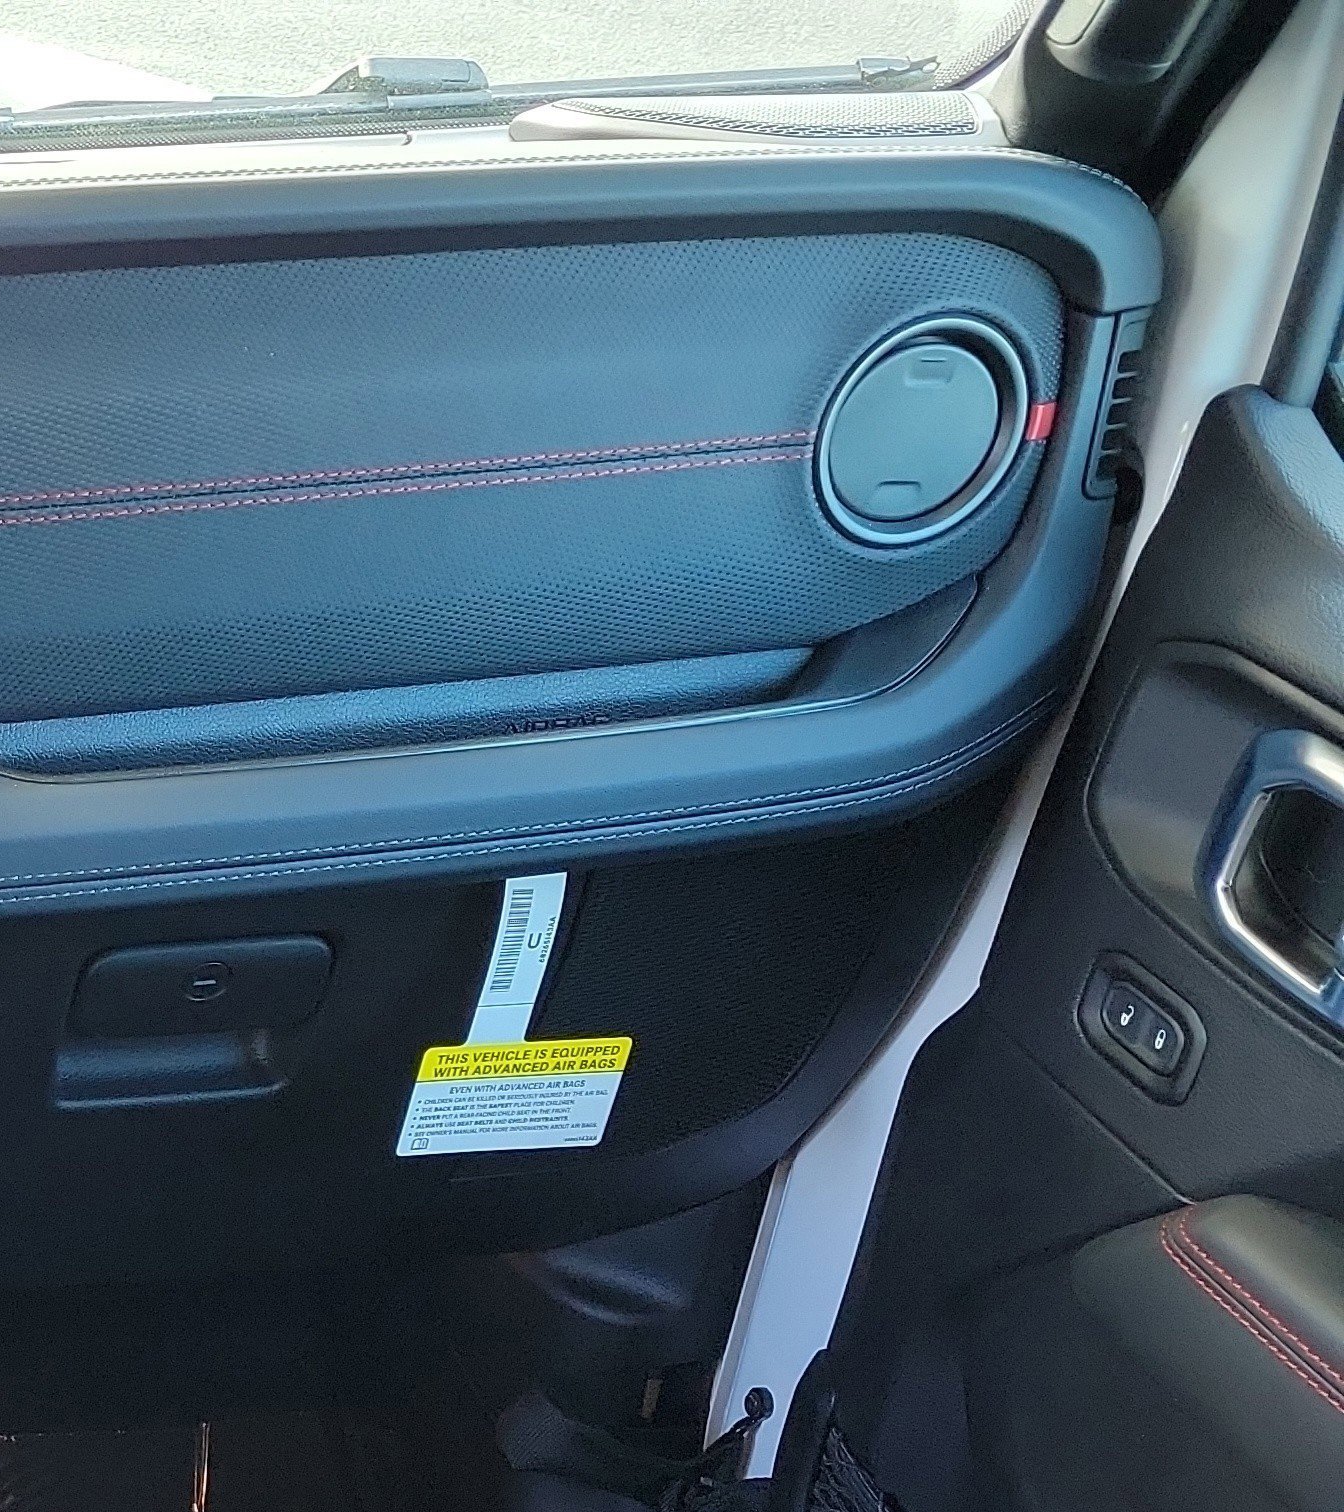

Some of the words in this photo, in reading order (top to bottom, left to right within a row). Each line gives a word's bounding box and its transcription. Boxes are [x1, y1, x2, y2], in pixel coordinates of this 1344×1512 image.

[437, 1053, 470, 1065] THIS
[472, 1050, 531, 1063] VEHICLE
[534, 1049, 549, 1059] IS
[550, 1045, 621, 1058] EQUIPPED
[433, 1066, 470, 1078] WITH
[471, 1062, 550, 1076] ADVANCED
[552, 1060, 577, 1071] AIR
[579, 1058, 617, 1070] BAGS
[450, 1085, 472, 1094] EVEN
[474, 1084, 497, 1093] WITH
[498, 1082, 545, 1092] ADVANCED
[546, 1081, 561, 1089] AIR
[563, 1080, 586, 1088] BAGS
